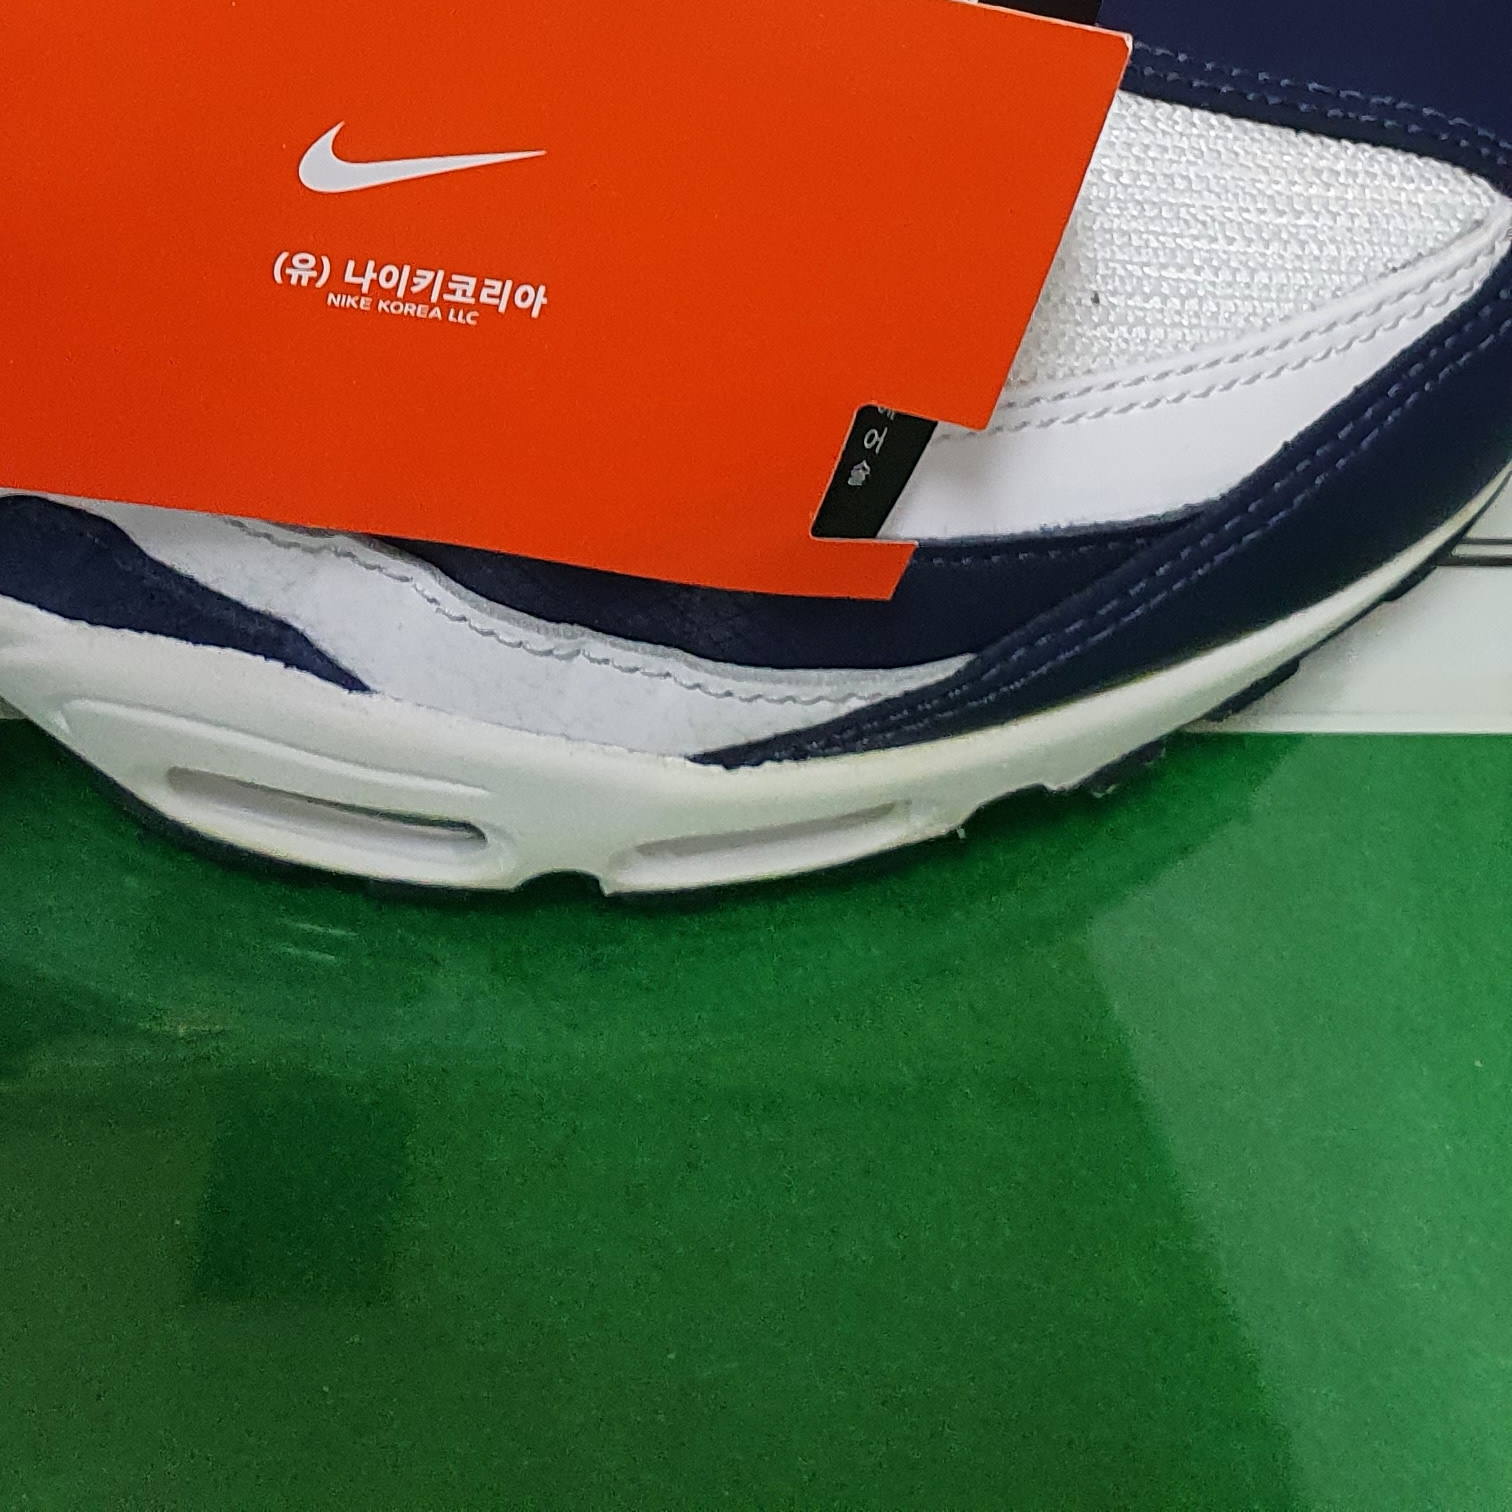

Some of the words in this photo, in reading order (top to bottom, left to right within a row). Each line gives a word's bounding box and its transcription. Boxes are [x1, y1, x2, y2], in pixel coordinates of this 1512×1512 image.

[273, 251, 330, 288] (유)
[343, 259, 548, 318] 나이키코리아
[326, 292, 372, 311] NIKE
[377, 299, 443, 321] KOREA
[448, 307, 480, 326] LLC
